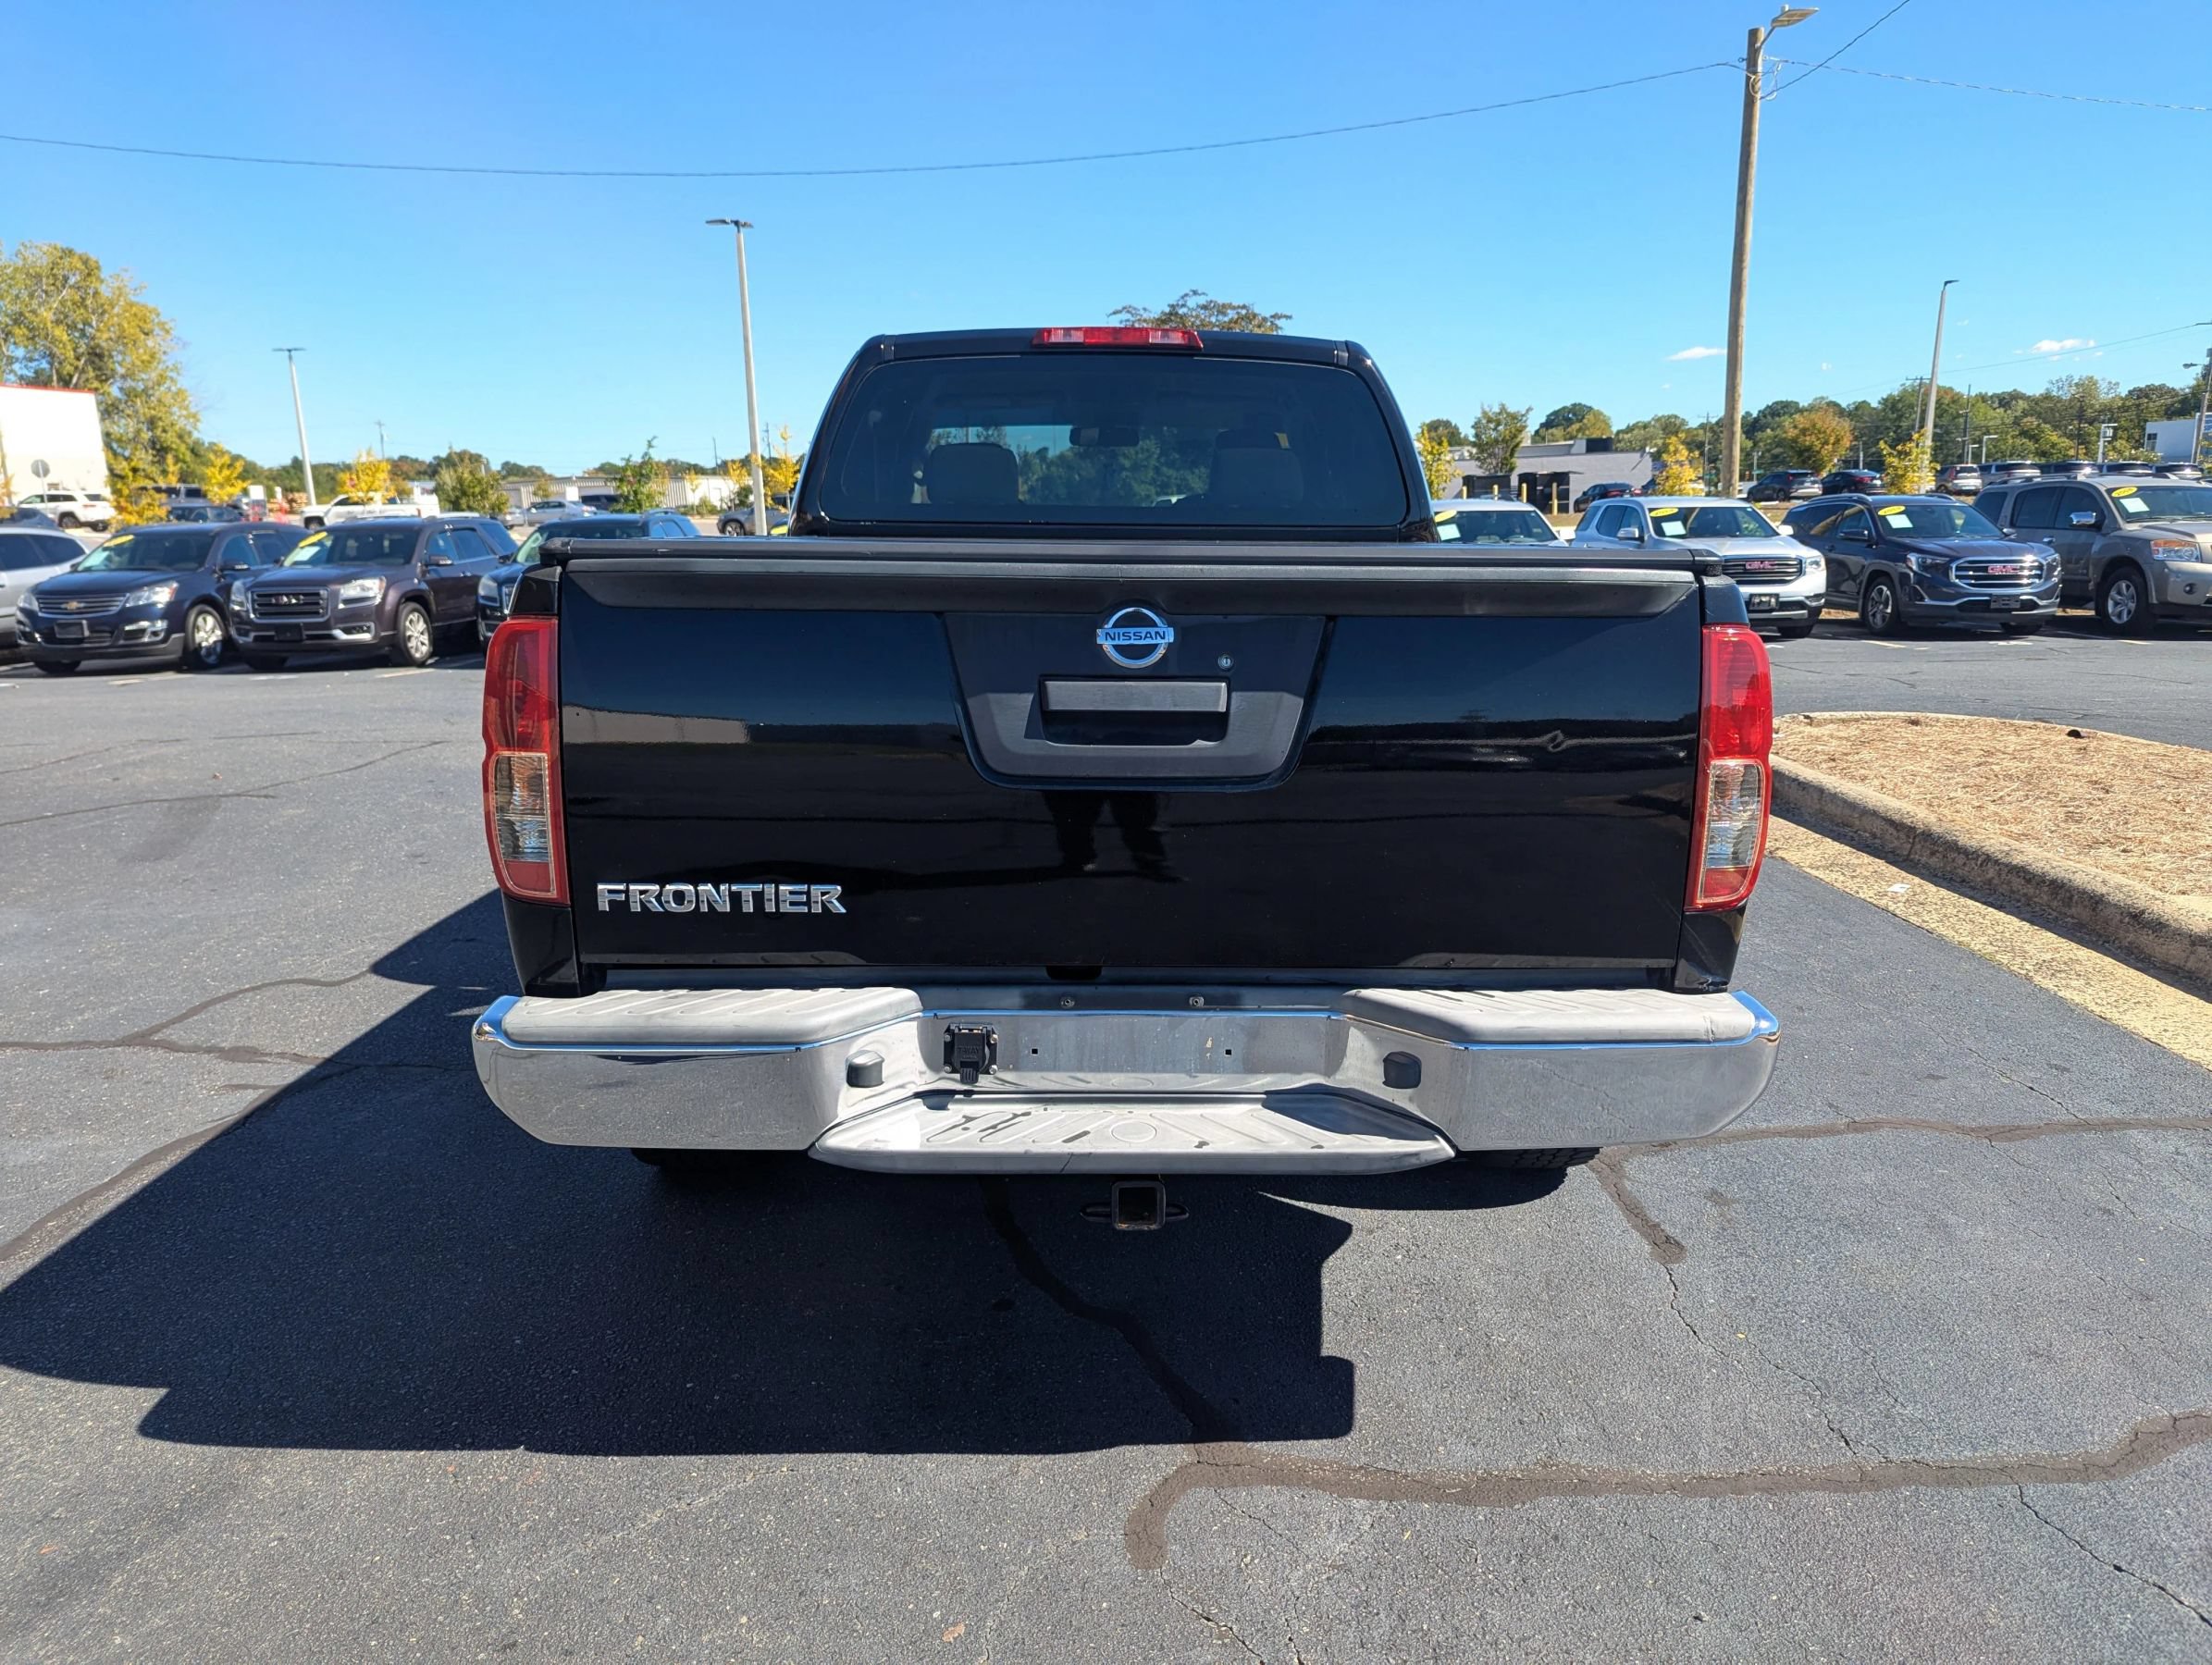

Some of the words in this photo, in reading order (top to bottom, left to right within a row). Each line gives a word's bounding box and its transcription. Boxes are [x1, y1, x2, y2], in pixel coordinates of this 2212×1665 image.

[1745, 561, 1777, 570] GMC
[1987, 565, 2020, 574] GMC
[1105, 631, 1166, 641] NISSAN
[596, 882, 847, 913] FRONTIER
